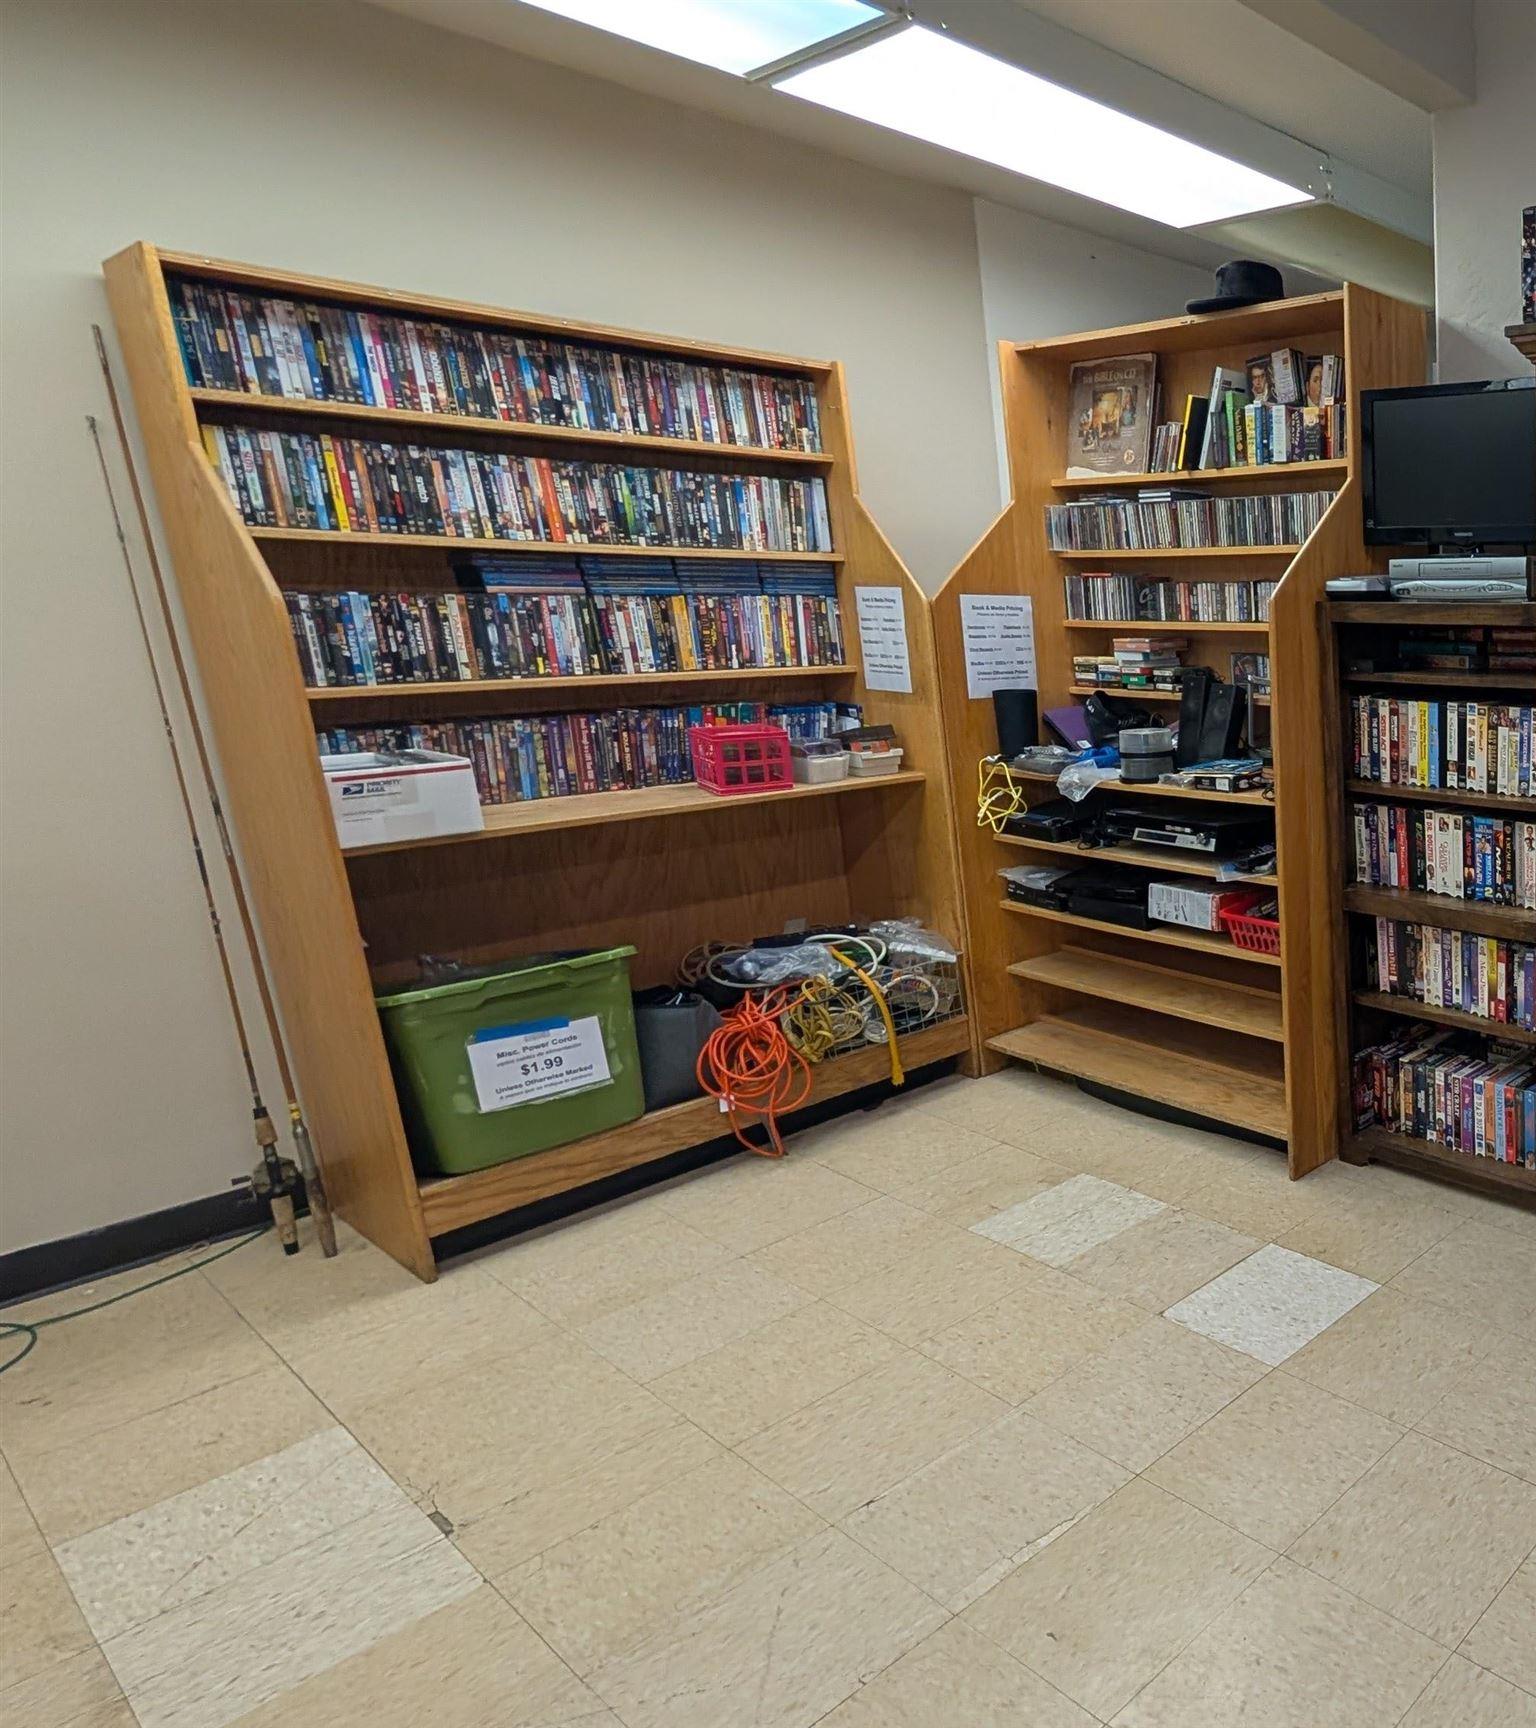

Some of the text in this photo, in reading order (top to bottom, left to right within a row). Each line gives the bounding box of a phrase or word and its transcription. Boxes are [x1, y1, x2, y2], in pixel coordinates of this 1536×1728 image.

[1094, 370, 1113, 382] BIBLE
[415, 476, 429, 503] snatch
[452, 613, 464, 650] TAKEN
[496, 1034, 578, 1059] Misc. Power Cords
[495, 1063, 594, 1094] Unless Otherwise Marked
[521, 1056, 564, 1076] $1.99
